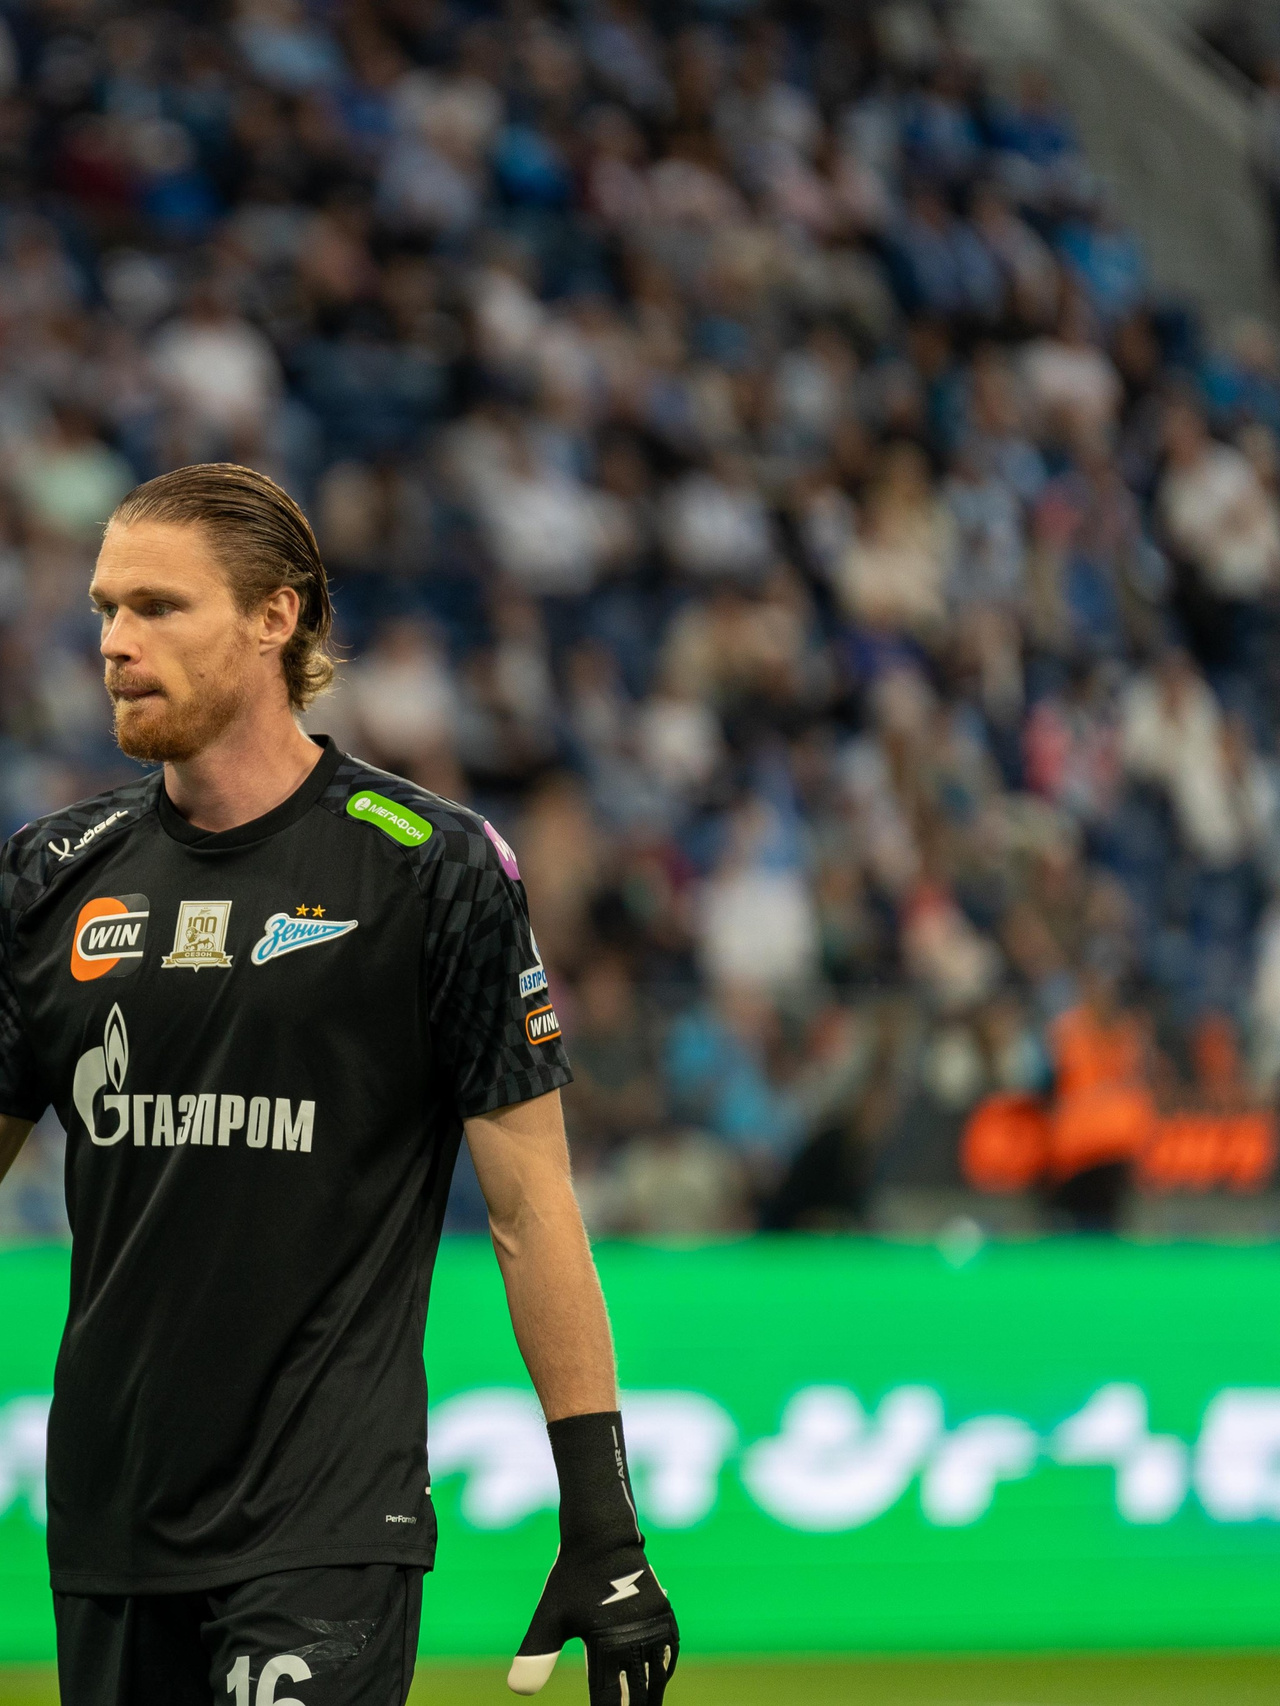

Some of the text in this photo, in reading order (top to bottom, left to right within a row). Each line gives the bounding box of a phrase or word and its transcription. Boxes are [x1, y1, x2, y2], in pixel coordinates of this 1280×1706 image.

[74, 810, 129, 851] JÖGEL
[368, 804, 424, 840] МЕГАФОН
[88, 923, 142, 950] WIN
[187, 916, 218, 934] 100
[133, 1093, 316, 1153] ГАЗПРОМ
[615, 1448, 626, 1480] AIR
